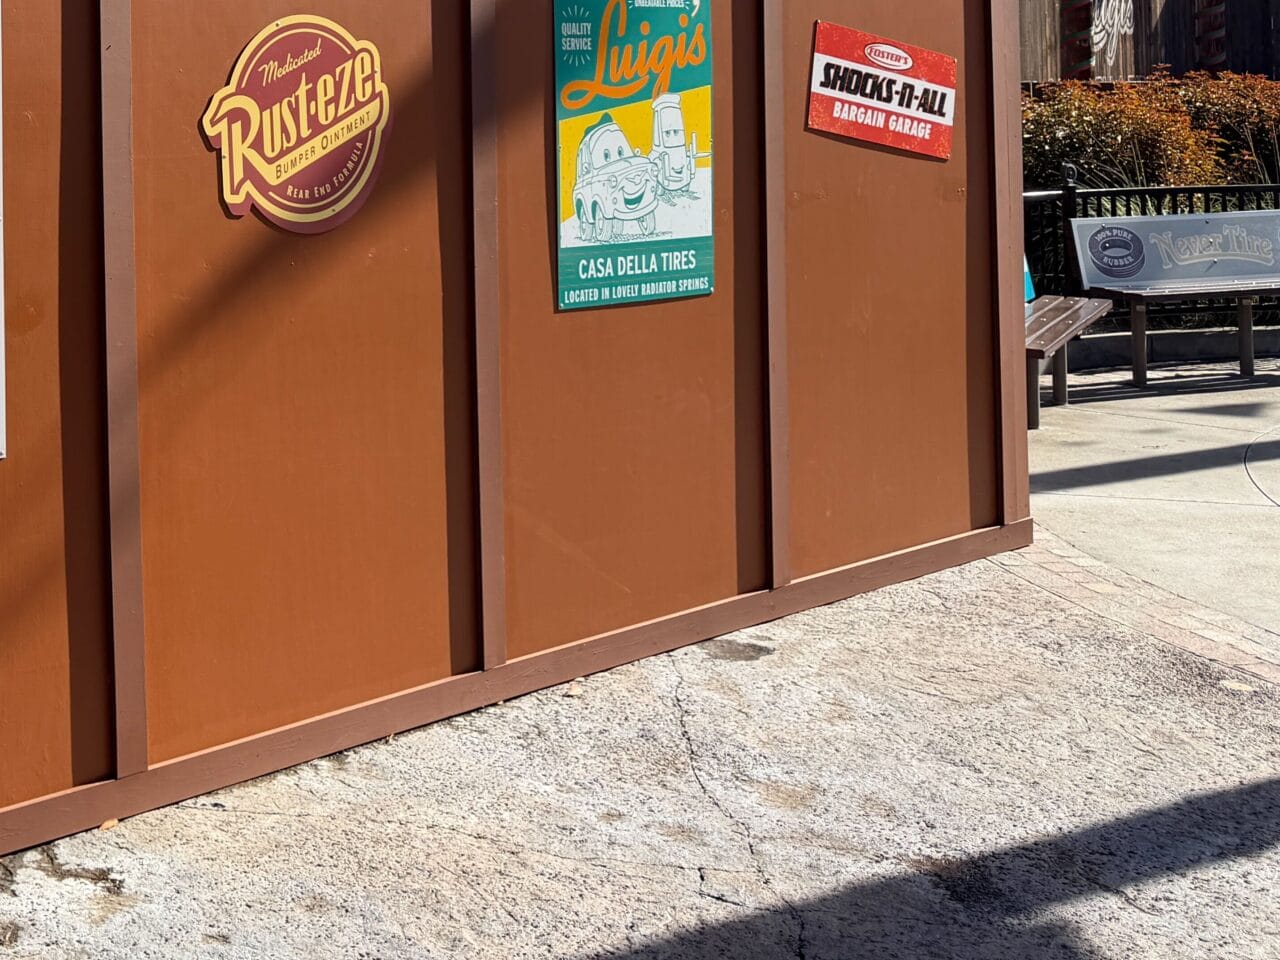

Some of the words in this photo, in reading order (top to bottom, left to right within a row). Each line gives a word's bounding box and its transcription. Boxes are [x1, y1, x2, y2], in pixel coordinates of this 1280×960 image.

[561, 23, 592, 36] QUALITY
[561, 38, 592, 50] SERVICE
[258, 38, 322, 87] Medicated
[870, 47, 909, 65] FOSTER'S
[833, 101, 886, 129] BARGAIN
[888, 114, 932, 140] GARAGE
[276, 146, 316, 179] BUMPER
[320, 110, 372, 150] OINTMENT
[286, 184, 310, 199] REAR
[314, 184, 332, 198] END
[333, 142, 363, 186] FORMULA
[1149, 232, 1221, 269] Never
[1222, 224, 1273, 257] Tire
[578, 258, 614, 279] CASA
[618, 254, 658, 276] DELLA
[660, 250, 696, 272] TIRES
[564, 288, 598, 304] LOCATED
[602, 287, 610, 300] IN
[612, 284, 639, 298] LOVELY
[642, 280, 677, 296] RADIATOR
[678, 277, 708, 292] SPRINGS
